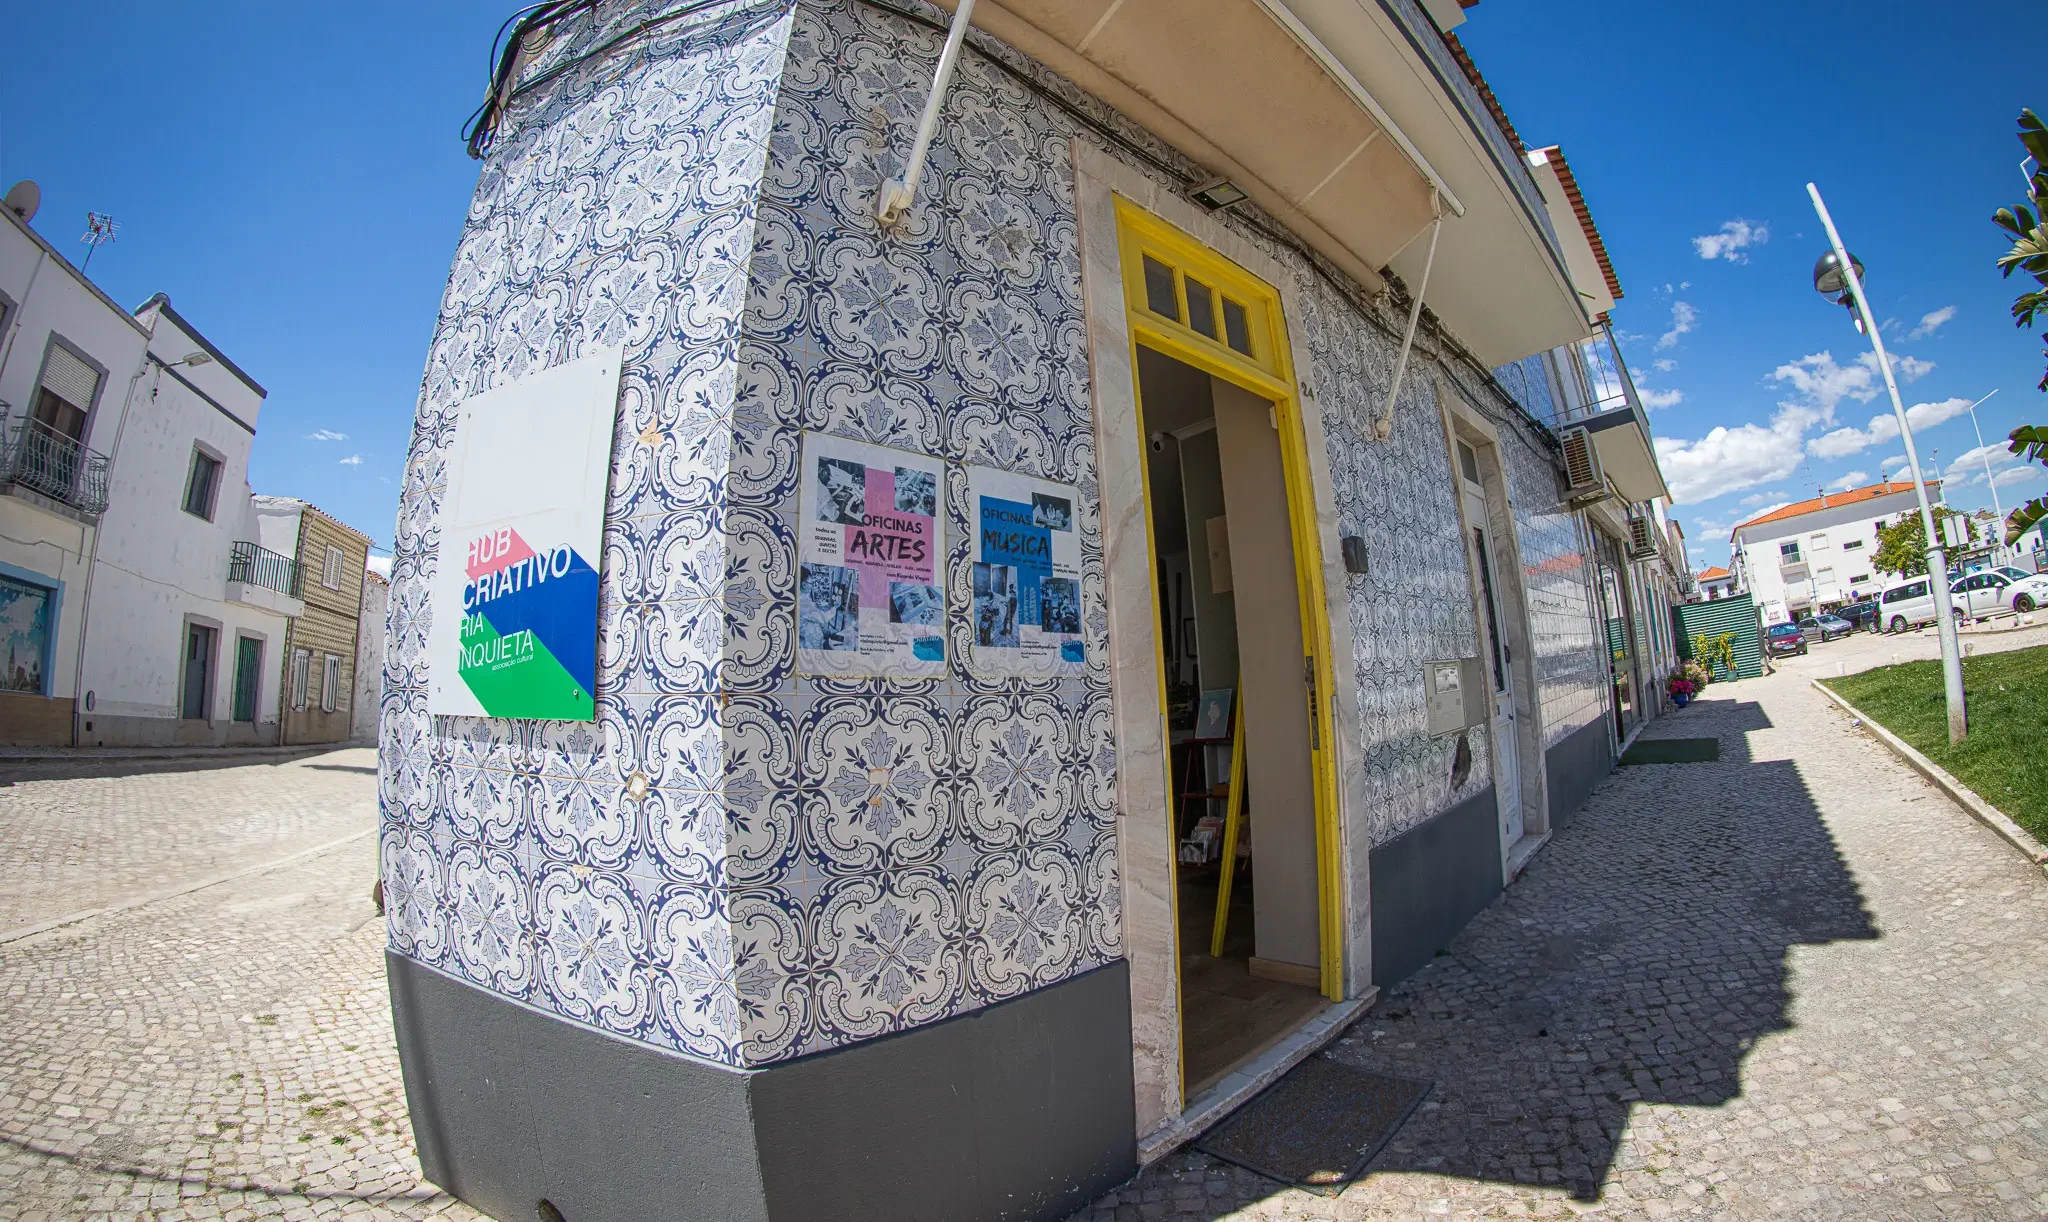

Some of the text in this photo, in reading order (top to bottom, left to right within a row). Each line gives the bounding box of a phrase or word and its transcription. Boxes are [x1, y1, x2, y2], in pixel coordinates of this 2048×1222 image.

[1301, 381, 1315, 401] 24
[862, 514, 922, 534] OFICINAS
[982, 508, 1033, 526] OFICINAS
[467, 525, 512, 568] HUB
[851, 530, 926, 563] ARTES
[983, 524, 1049, 561] MÚSICA
[461, 542, 573, 611] CRIATIVO
[459, 611, 484, 640] RIA
[457, 628, 534, 671] INQUIETA
[491, 653, 534, 671] associação cultural
